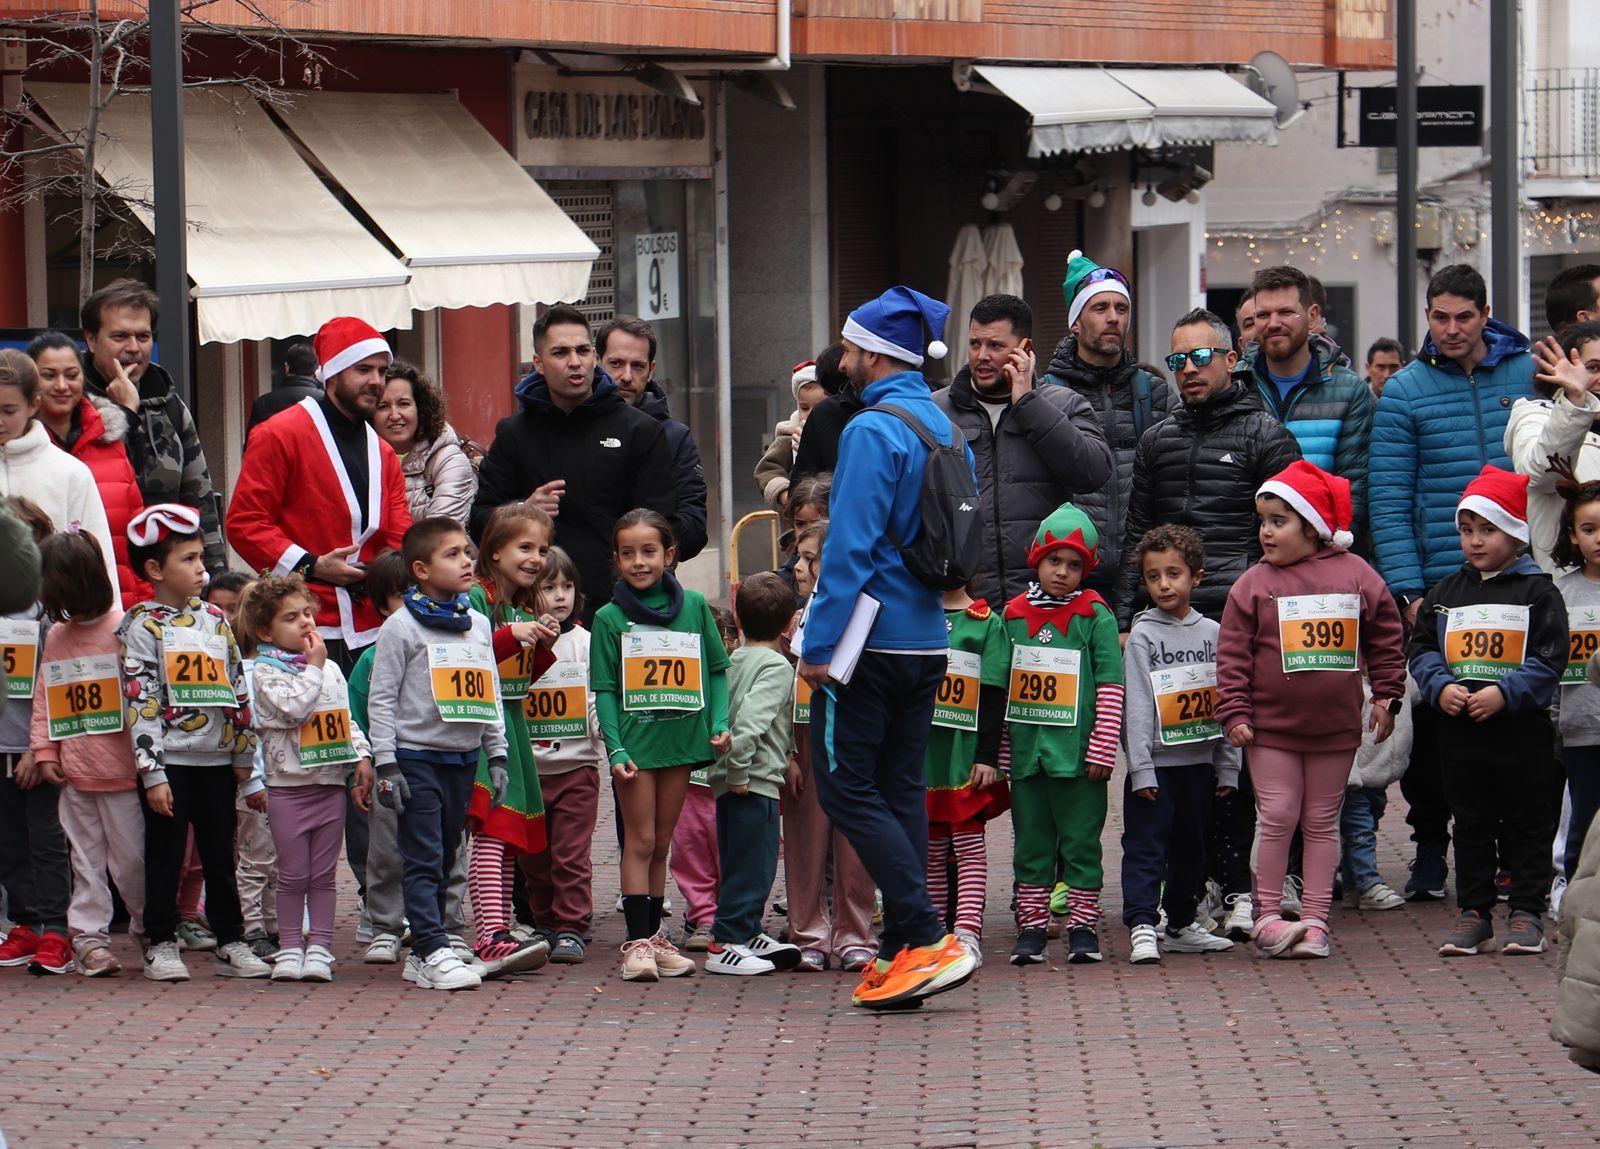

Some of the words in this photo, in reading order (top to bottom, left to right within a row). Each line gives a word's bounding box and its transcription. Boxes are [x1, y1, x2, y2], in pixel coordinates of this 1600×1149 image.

[637, 235, 676, 256] BOLSOS
[649, 257, 661, 315] 9
[1301, 620, 1345, 648] 399
[1460, 631, 1504, 659] 398
[175, 654, 219, 682] 213
[1287, 656, 1306, 667] JUNTA
[1308, 655, 1317, 664] DE
[1318, 655, 1354, 665] EXTREMADURA
[1463, 664, 1470, 673] DE
[643, 659, 686, 687] 270
[1575, 668, 1583, 677] DE
[450, 669, 485, 699] 180
[516, 682, 524, 692] DE
[936, 675, 965, 705] 09
[1019, 672, 1057, 702] 298
[65, 682, 103, 713] 188
[181, 689, 190, 699] DE
[192, 689, 234, 700] EXTREMADURA
[628, 693, 647, 705] JUNTA
[649, 693, 658, 703] DE
[660, 692, 700, 705] EXTREMADURA
[457, 704, 465, 714] DE
[466, 705, 497, 717] EXTREMADURA
[526, 690, 568, 718] 300
[1021, 706, 1029, 716] DE
[1029, 707, 1073, 720] EXTREMADURA
[1177, 689, 1213, 721] 228
[934, 708, 974, 723] EXTREMADURA
[54, 722, 72, 735] JUNTA
[72, 721, 80, 731] DE
[311, 711, 346, 742] 181
[531, 725, 538, 734] DE
[540, 722, 584, 734] EXTREMADURA
[1165, 729, 1184, 740] JUNTA
[1186, 727, 1194, 736] DE
[320, 749, 328, 759] DE
